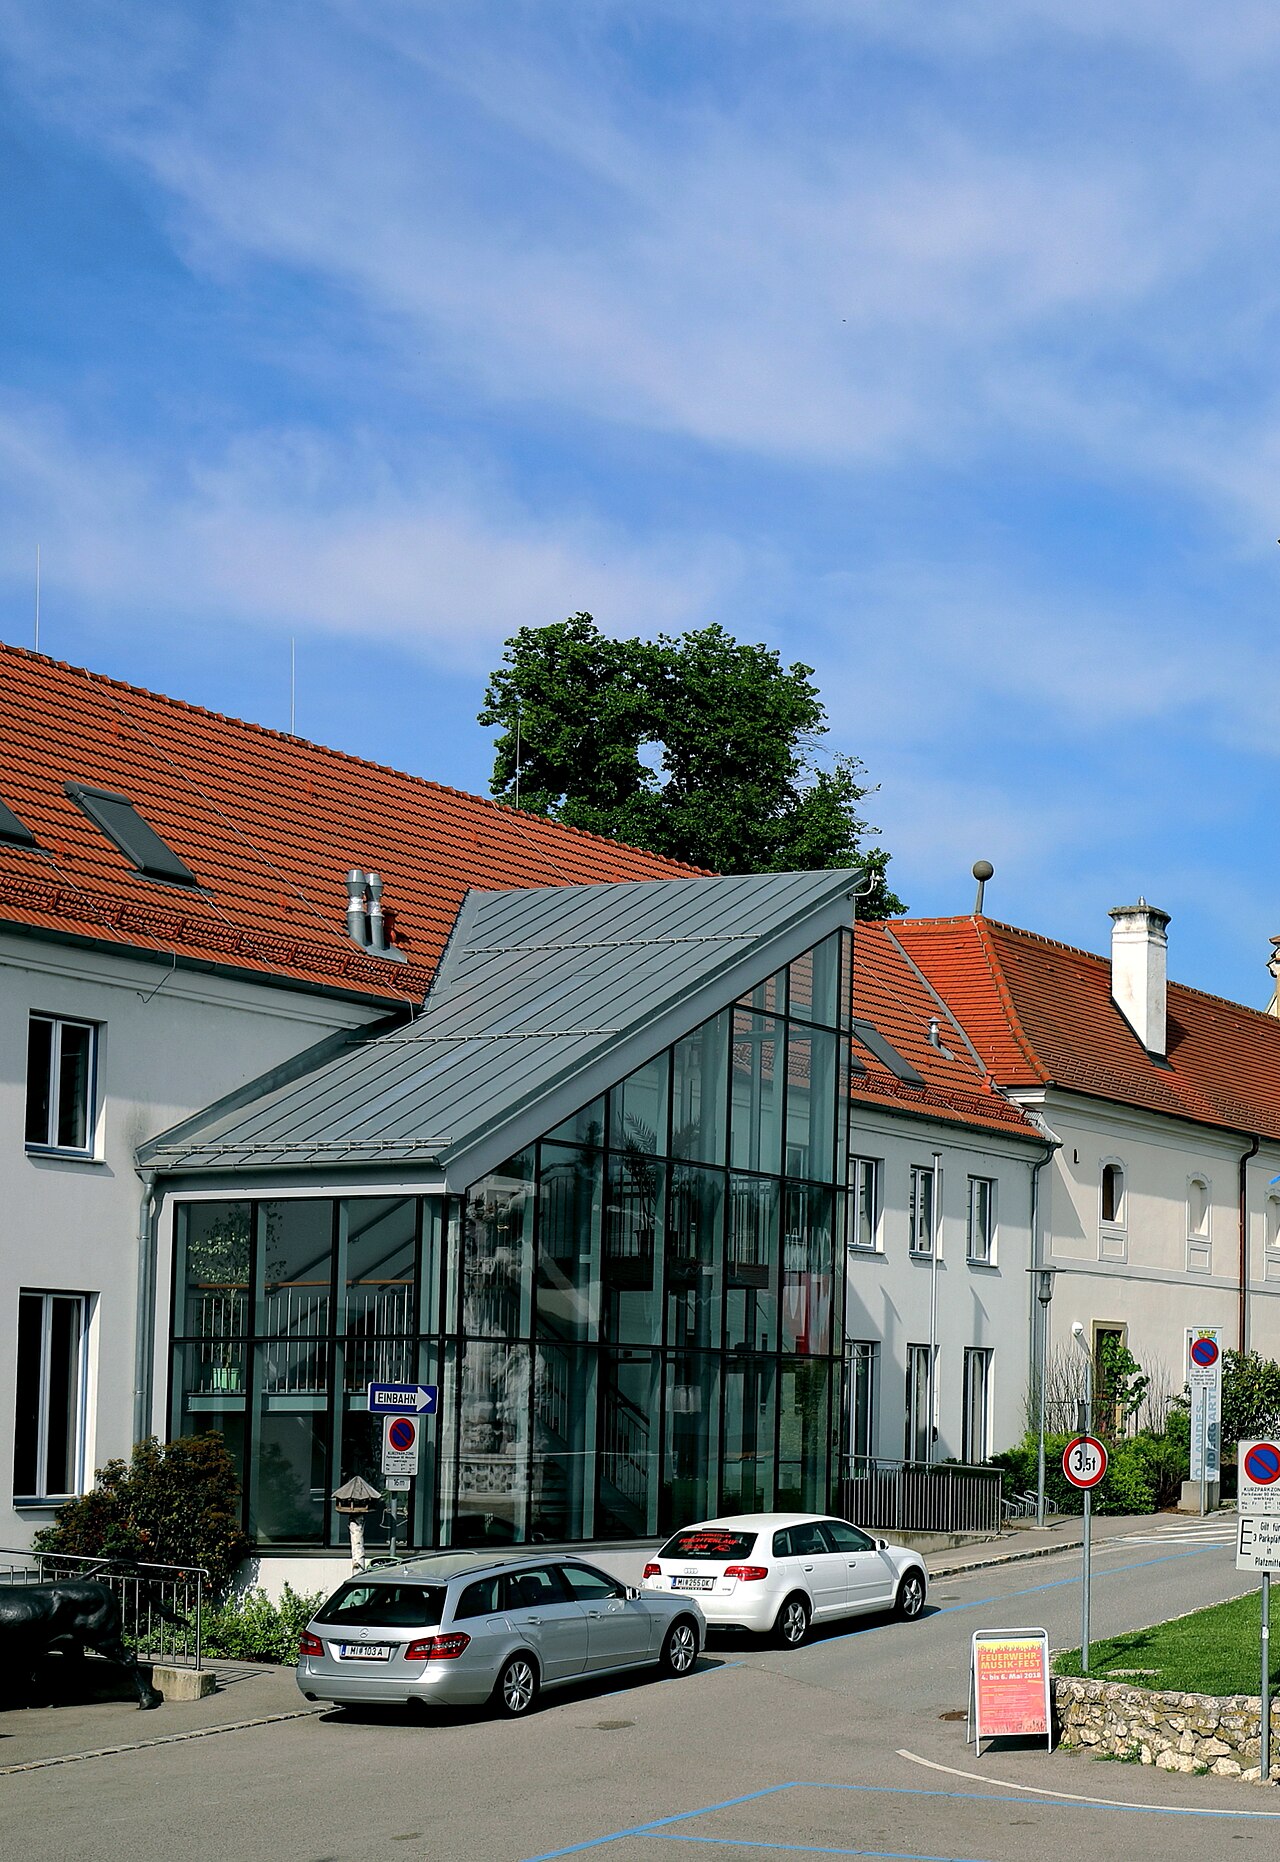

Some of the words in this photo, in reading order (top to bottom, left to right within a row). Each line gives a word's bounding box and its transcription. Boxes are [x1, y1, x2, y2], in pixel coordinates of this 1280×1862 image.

[377, 1392, 416, 1404] EINBAHN
[1074, 1450, 1096, 1472] 3,5t
[1260, 1522, 1269, 1531] Gilt
[1272, 1523, 1280, 1531] für
[1266, 1546, 1271, 1554] in
[688, 1579, 701, 1587] 255
[981, 1652, 1041, 1661] FEUERWEHR-
[981, 1660, 1041, 1669] MUSIK-FEST
